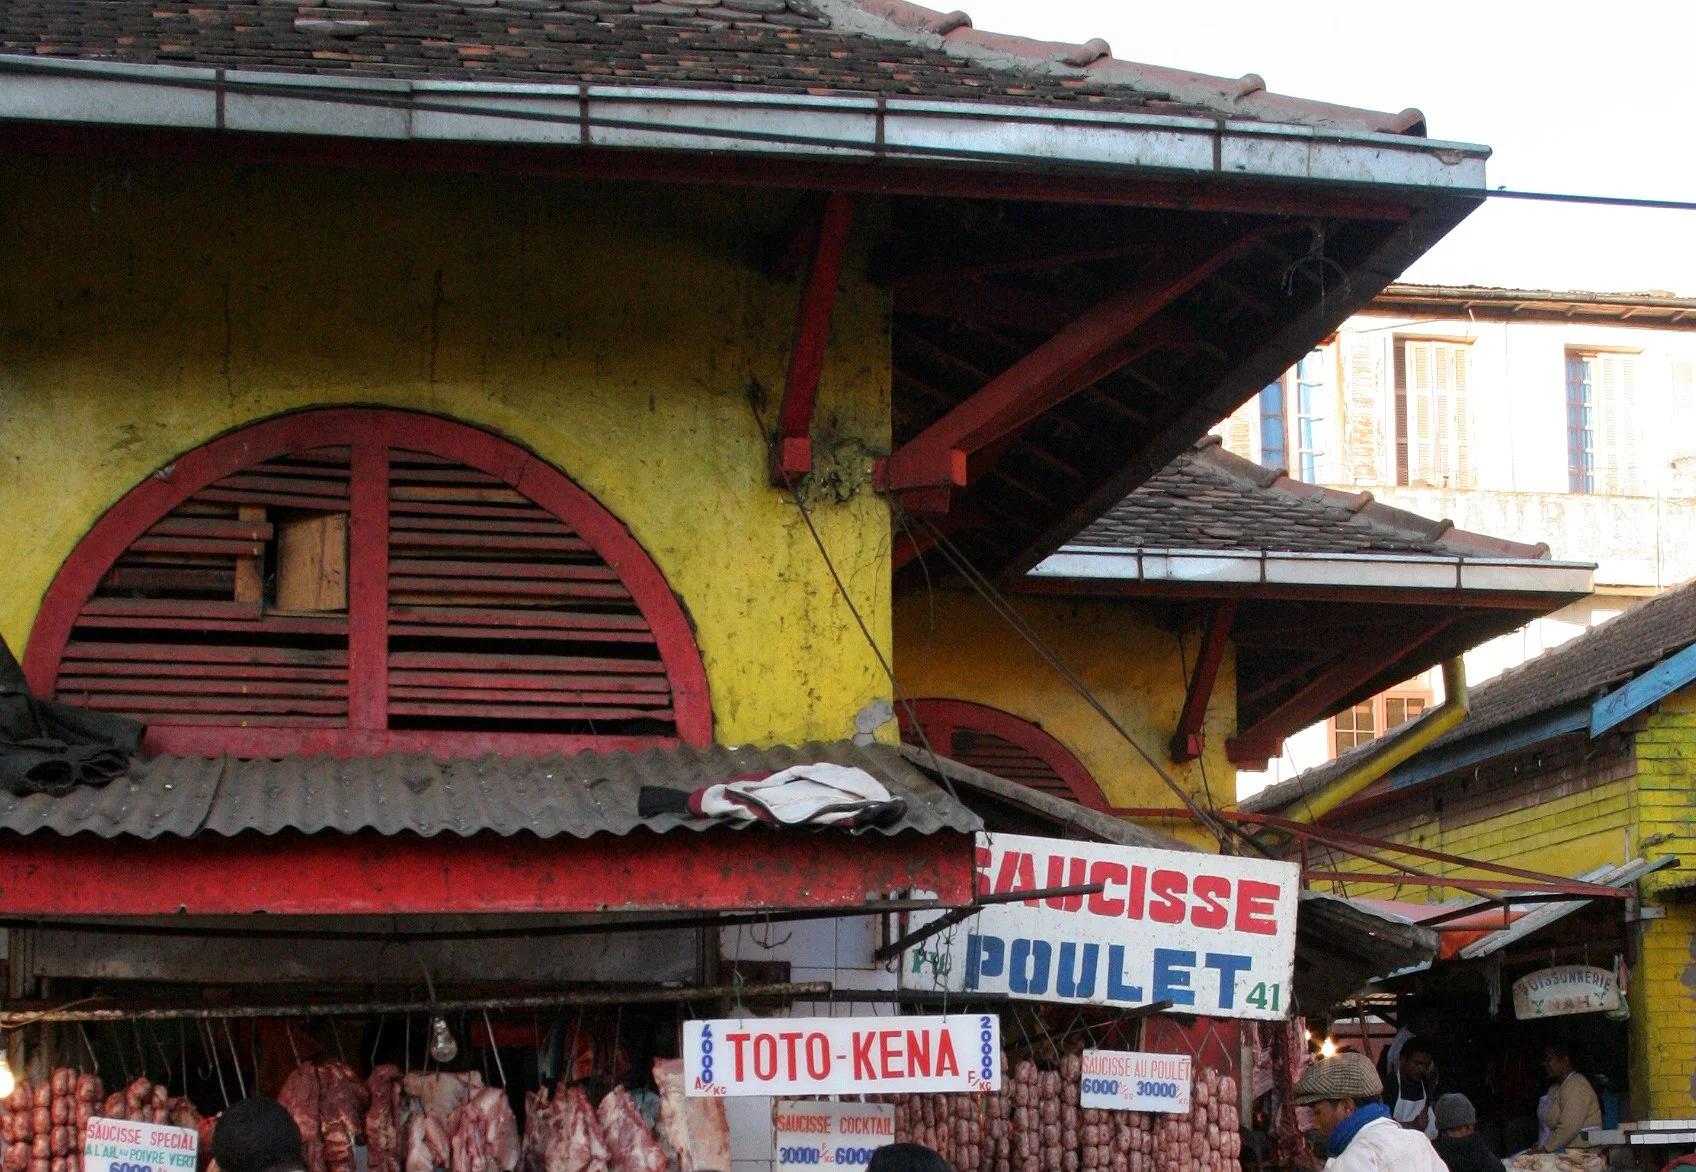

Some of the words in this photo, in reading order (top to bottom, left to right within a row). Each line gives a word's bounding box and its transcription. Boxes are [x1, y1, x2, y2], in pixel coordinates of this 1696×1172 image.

[965, 934, 1252, 1010] POULET
[1246, 981, 1281, 1011] 41
[701, 1023, 713, 1084] 4000
[980, 1016, 993, 1081] 20000
[1082, 1056, 1131, 1077] SAUCISSE
[1134, 1060, 1146, 1078] AU
[1151, 1060, 1191, 1081] POULET
[1082, 1078, 1118, 1095] 6000
[1136, 1080, 1177, 1098] 30000
[777, 1112, 832, 1133] SAUCISSE
[840, 1116, 894, 1135] COCKTAIL
[87, 1124, 142, 1144] SAUCISSE
[150, 1131, 195, 1151] SPECIAL
[129, 1148, 165, 1164] POIVRE
[168, 1153, 197, 1168] VERT
[779, 1147, 820, 1164] 30000
